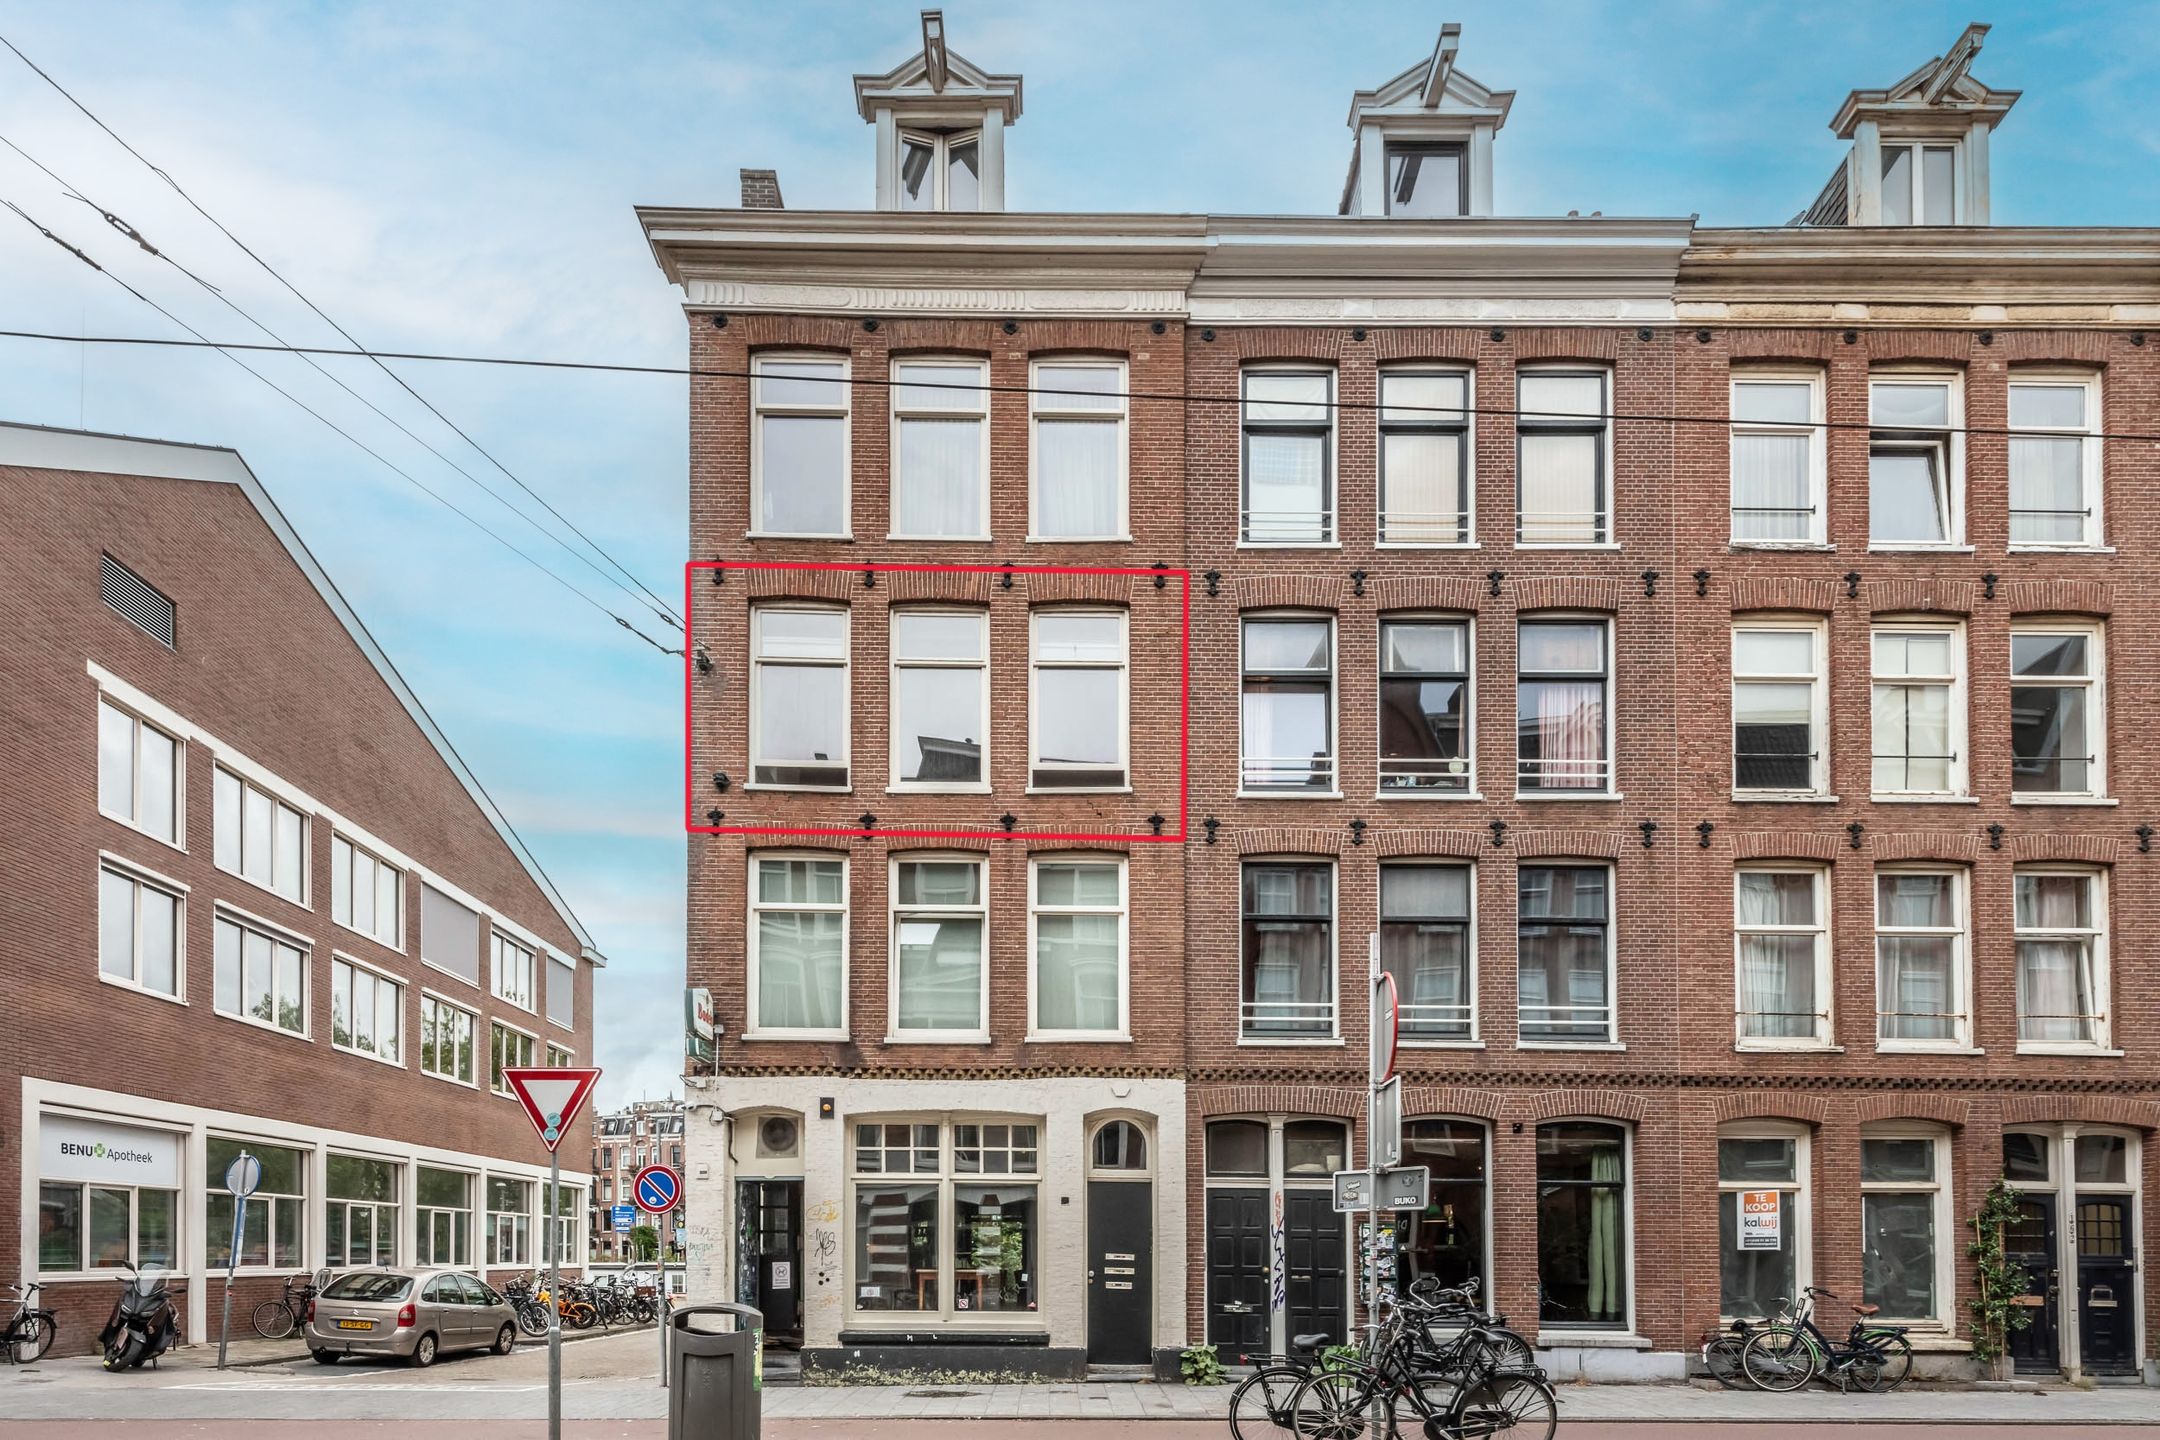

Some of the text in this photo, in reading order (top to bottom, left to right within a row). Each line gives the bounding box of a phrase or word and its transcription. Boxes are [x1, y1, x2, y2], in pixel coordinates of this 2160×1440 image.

[61, 1142, 153, 1163] BENU Apotheek
[1394, 1196, 1417, 1205] BUKO
[1754, 1193, 1767, 1202] TE
[1745, 1202, 1776, 1212] KOOP
[1744, 1216, 1777, 1229] kalwij
